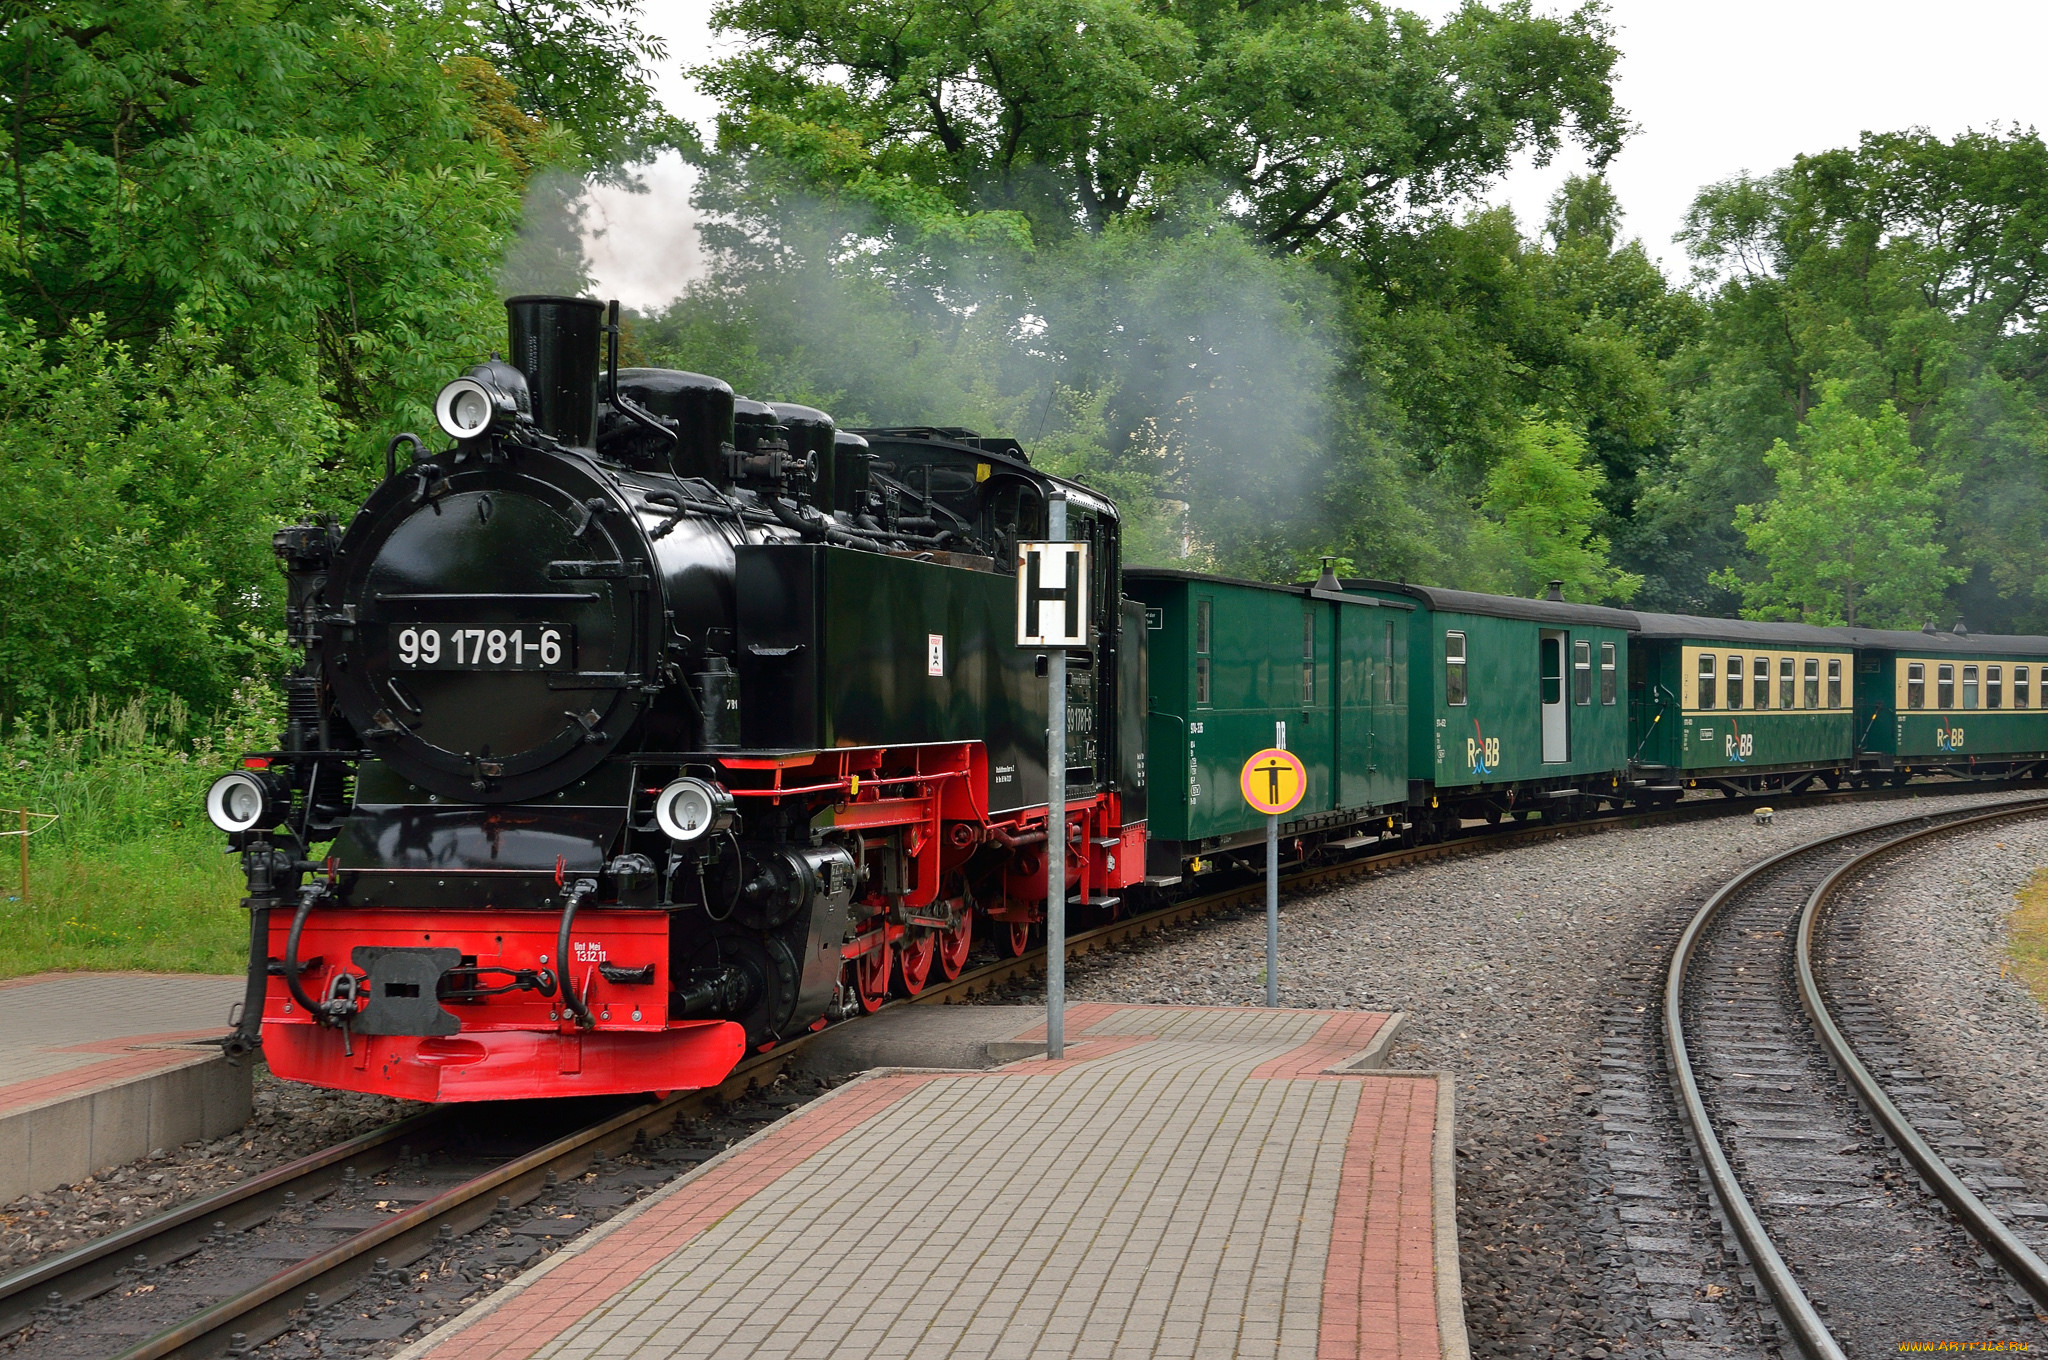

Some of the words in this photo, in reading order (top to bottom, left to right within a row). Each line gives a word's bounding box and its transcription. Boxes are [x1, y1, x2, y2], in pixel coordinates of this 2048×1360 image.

[1026, 551, 1080, 637] H
[398, 629, 441, 664] 99
[450, 629, 562, 665] 1781-6
